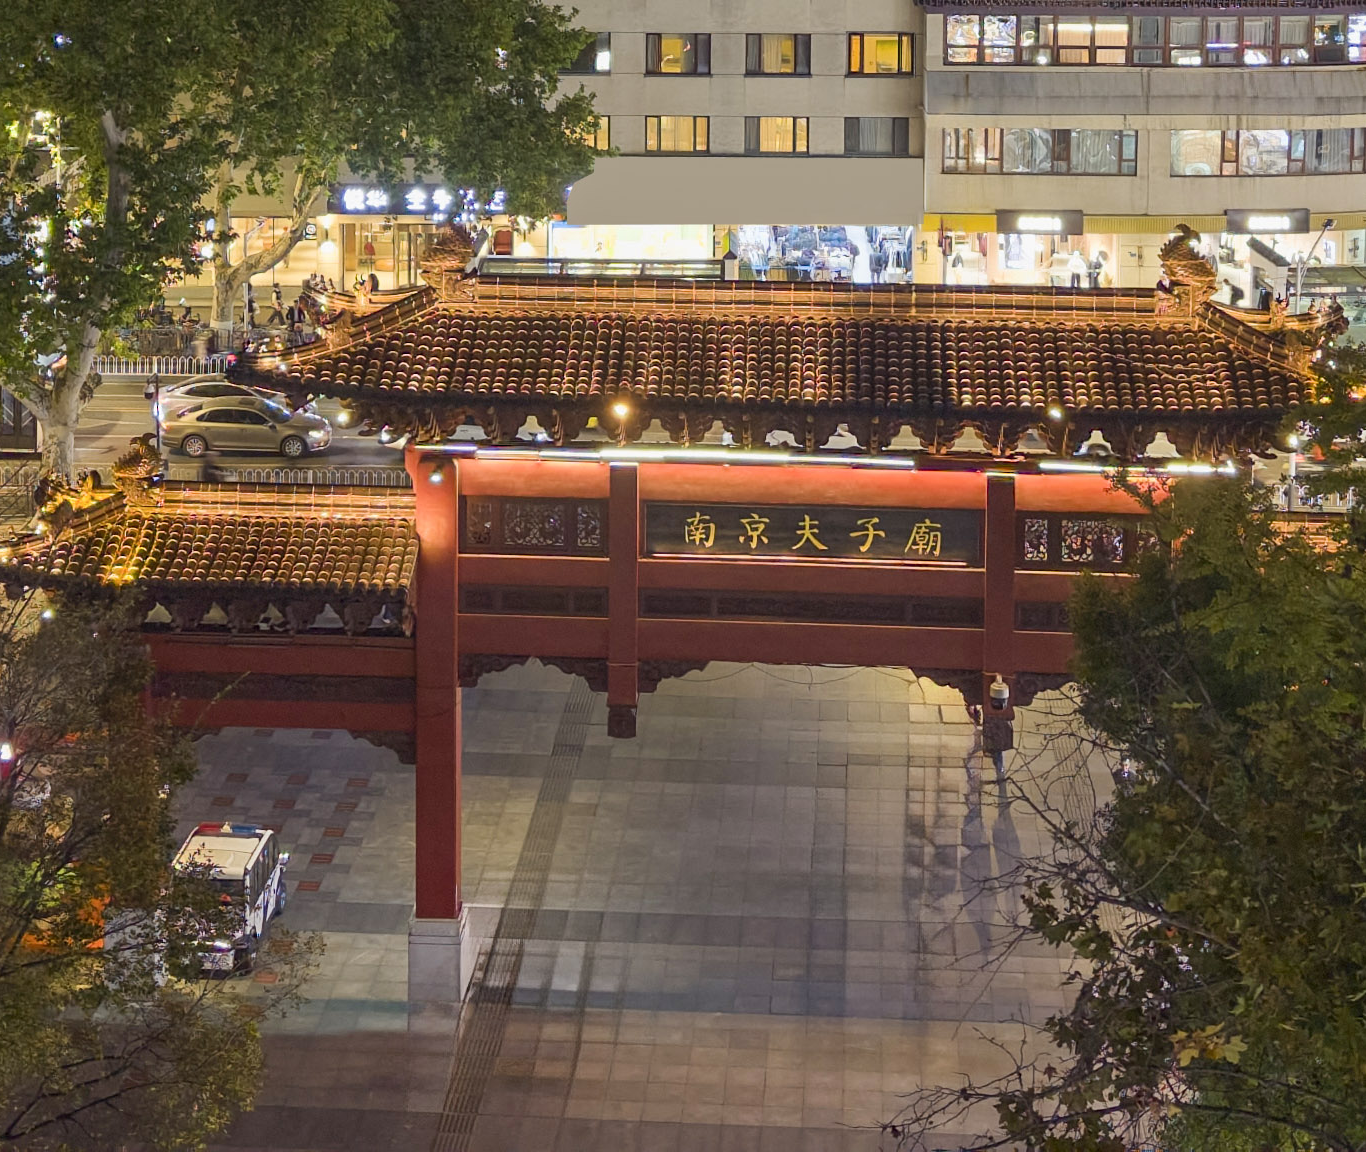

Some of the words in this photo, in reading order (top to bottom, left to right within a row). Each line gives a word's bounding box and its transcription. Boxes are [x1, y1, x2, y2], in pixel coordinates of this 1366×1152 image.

[683, 511, 942, 557] 南京夫子廟
